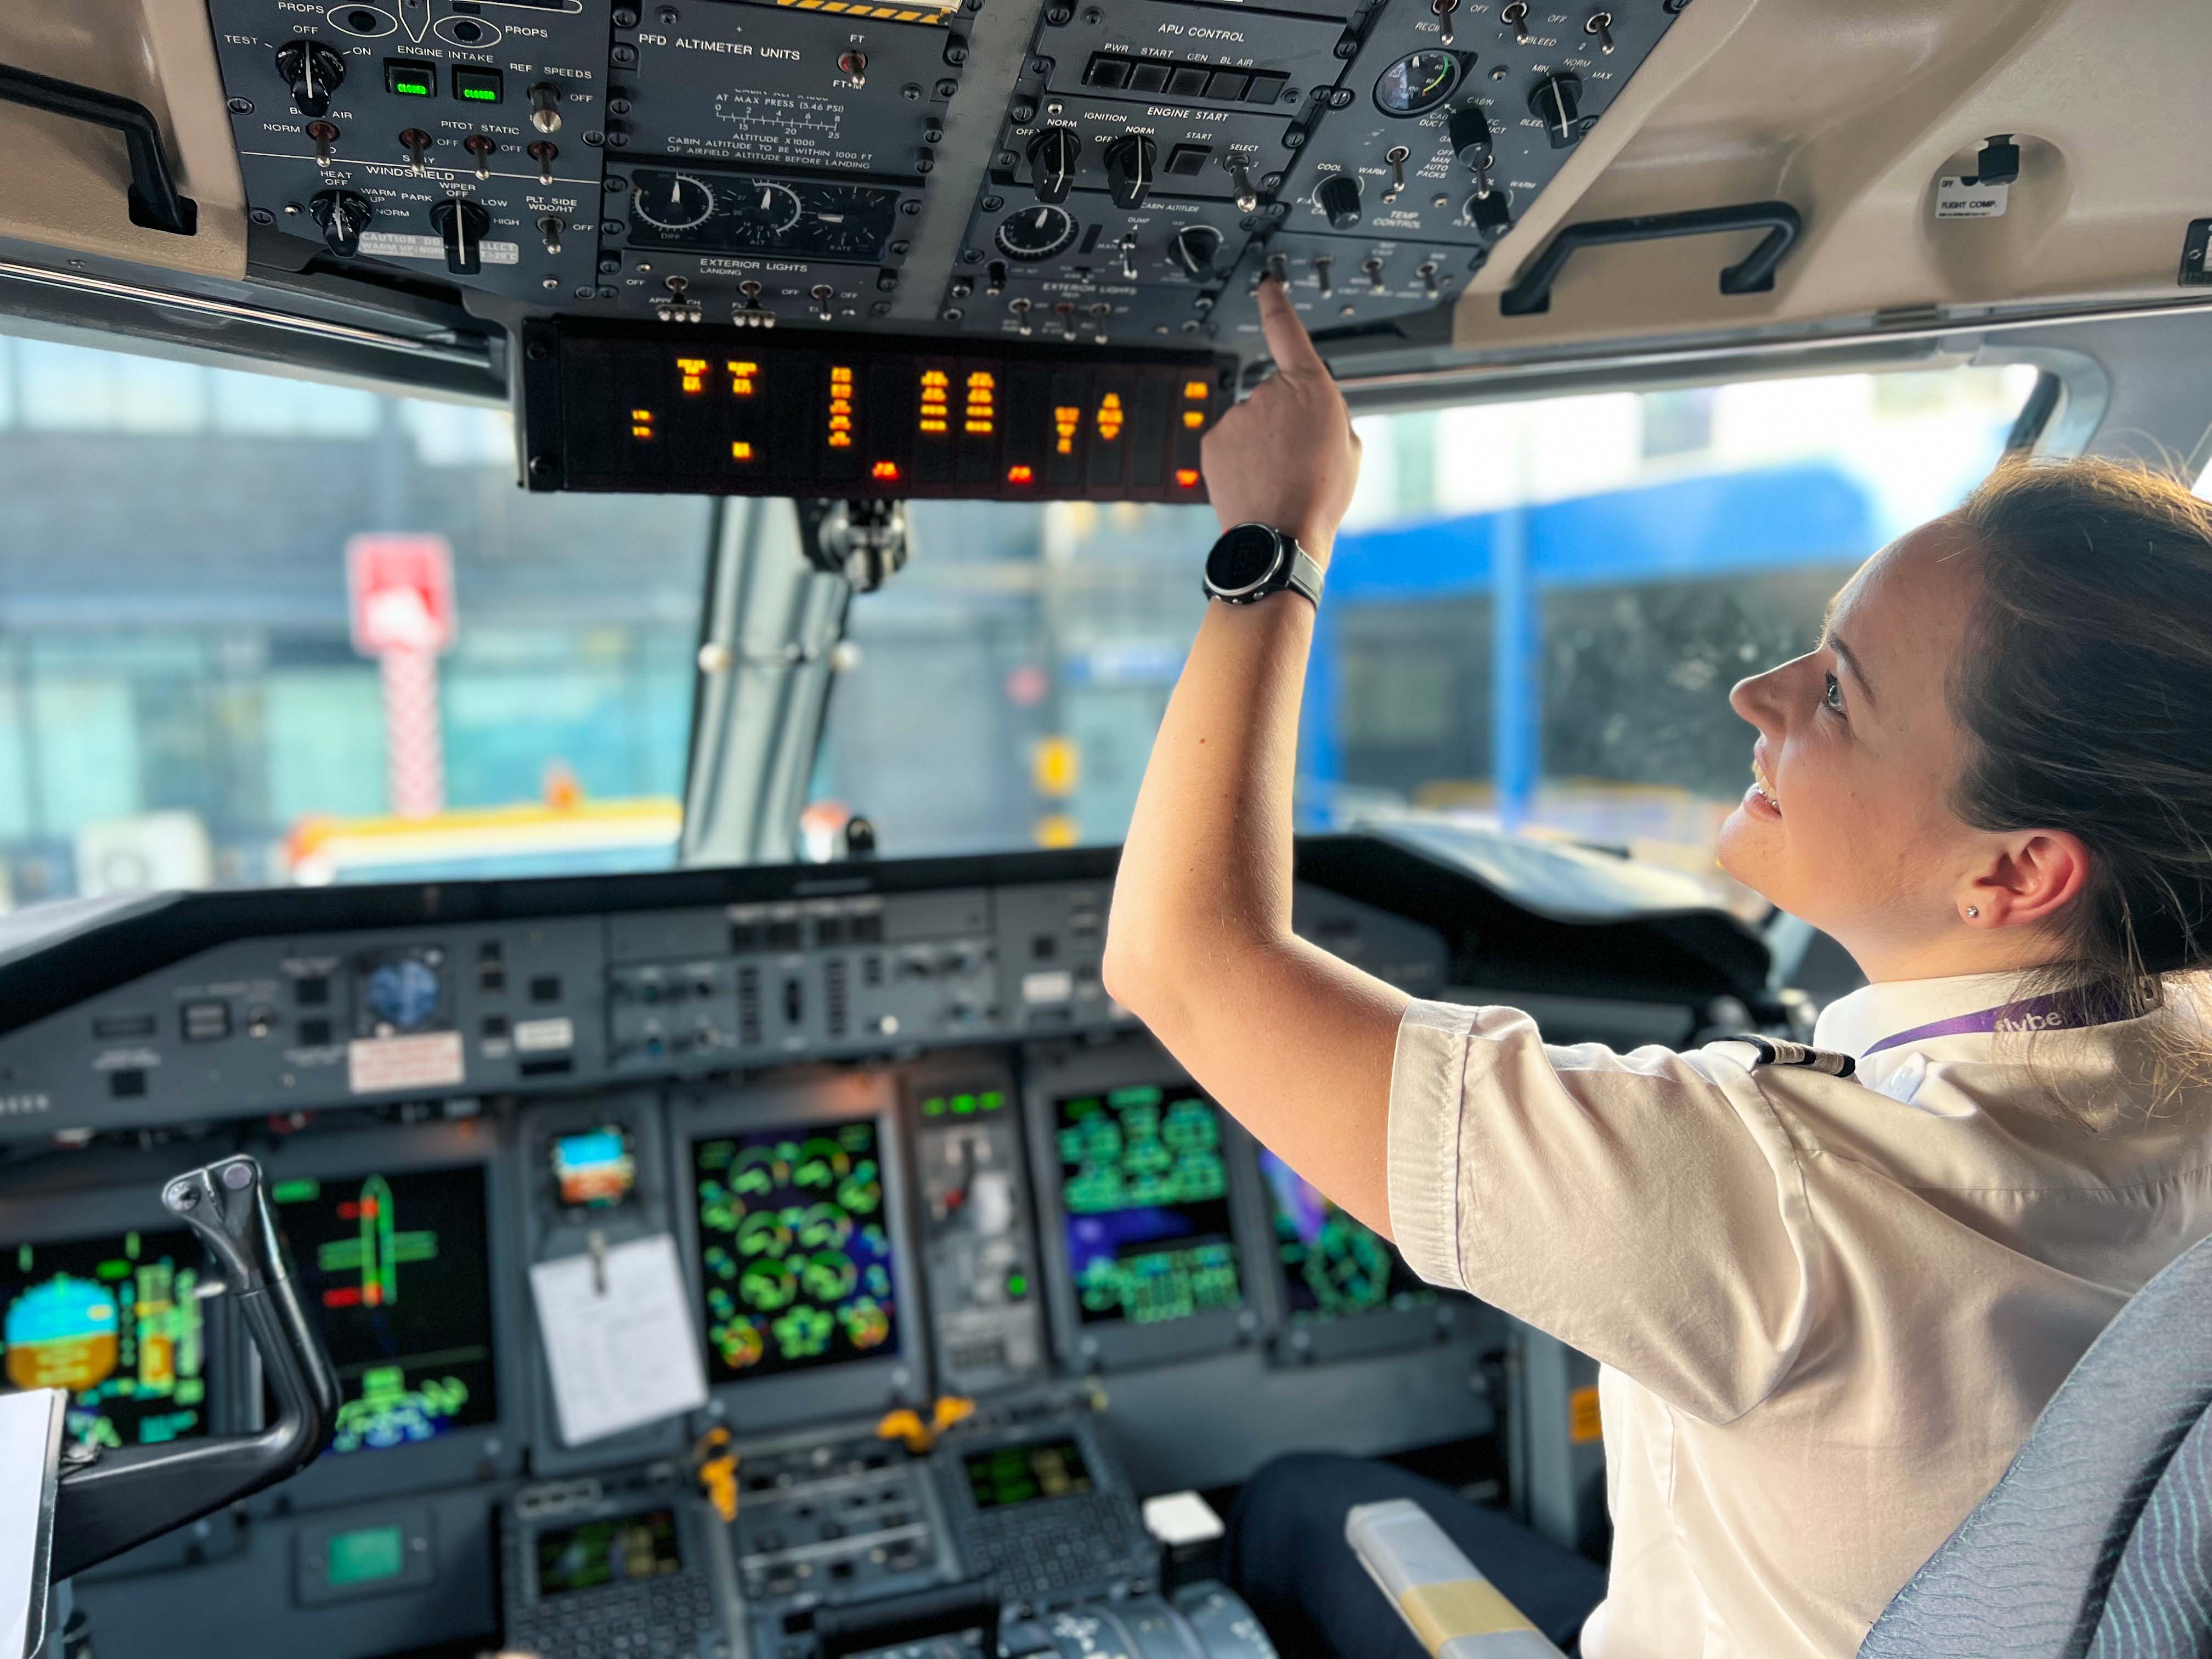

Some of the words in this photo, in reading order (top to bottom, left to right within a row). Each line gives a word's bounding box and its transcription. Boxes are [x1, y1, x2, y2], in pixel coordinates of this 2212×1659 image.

[278, 2, 325, 14] PROPS
[1470, 5, 1489, 13] OFF
[1547, 15, 1567, 23] OFF
[293, 25, 319, 34] OFF
[505, 25, 548, 38] PROPS
[1158, 24, 1183, 35] APU
[1188, 27, 1245, 42] CONTROL
[224, 35, 258, 44] TEST
[850, 34, 865, 43] FT
[1527, 36, 1557, 47] BLEED
[353, 47, 371, 55] ON
[639, 33, 667, 46] PFD
[675, 38, 753, 55] ALTIMETER
[760, 47, 800, 61] UNITS
[1104, 43, 1128, 52] PWR
[398, 46, 443, 57] ENGINE
[448, 51, 494, 63] INTAKE
[1141, 48, 1173, 58] START
[1187, 53, 1208, 61] GEN
[1220, 57, 1232, 65] BL
[1237, 59, 1253, 67] AIR
[1564, 58, 1590, 68] NORM
[510, 63, 532, 72] REF
[544, 66, 592, 79] SPEEDS
[1532, 65, 1549, 73] MIN
[1592, 72, 1613, 80] MAX
[397, 83, 426, 94] CLOSED
[465, 89, 495, 100] CLOSED
[570, 94, 593, 103] OFF
[734, 96, 759, 104] MAX
[765, 99, 794, 108] PRESS
[827, 104, 844, 113] PSI)
[1467, 97, 1494, 105] CABIN
[332, 111, 352, 119] AIR
[1084, 112, 1127, 123] IGNITION
[1147, 108, 1189, 118] ENGINE
[1195, 112, 1228, 122] START
[263, 123, 301, 133] NORM
[441, 121, 473, 131] PITOT
[482, 125, 520, 135] STATIC
[1047, 119, 1077, 128] NORM
[1419, 119, 1444, 128] DUCT
[1125, 126, 1154, 134] NORM
[732, 133, 779, 143] ALTITUDE
[668, 137, 700, 145] CABIN
[706, 140, 752, 150] ALTITUDE
[795, 148, 830, 156] WITHIN
[1230, 143, 1259, 151] SELECT
[687, 147, 729, 157] AIRFIELD
[735, 151, 780, 162] ALTITUDE
[785, 156, 821, 165] BEFORE
[826, 159, 870, 170] LANDING
[320, 170, 352, 179] HEAT
[366, 166, 454, 181] WINDSHIELD
[1359, 167, 1386, 176] WARM
[439, 182, 476, 191] WIPER
[361, 188, 396, 196] WARM
[402, 193, 432, 202] PARK
[481, 199, 507, 207] LOW
[551, 198, 578, 207] SIDE
[376, 208, 409, 217] NORM
[528, 204, 574, 213] WDO/HT
[1391, 211, 1419, 219] TEMP
[494, 218, 520, 226] HIGH
[1373, 218, 1420, 229] CONTROL
[362, 232, 416, 245] CAUTION
[701, 258, 760, 269] EXTERIOR
[766, 263, 808, 272] LIGHTS
[701, 268, 741, 276] LANDING
[1043, 283, 1096, 292] EXTERIOR
[1100, 286, 1137, 295] LIGHTS
